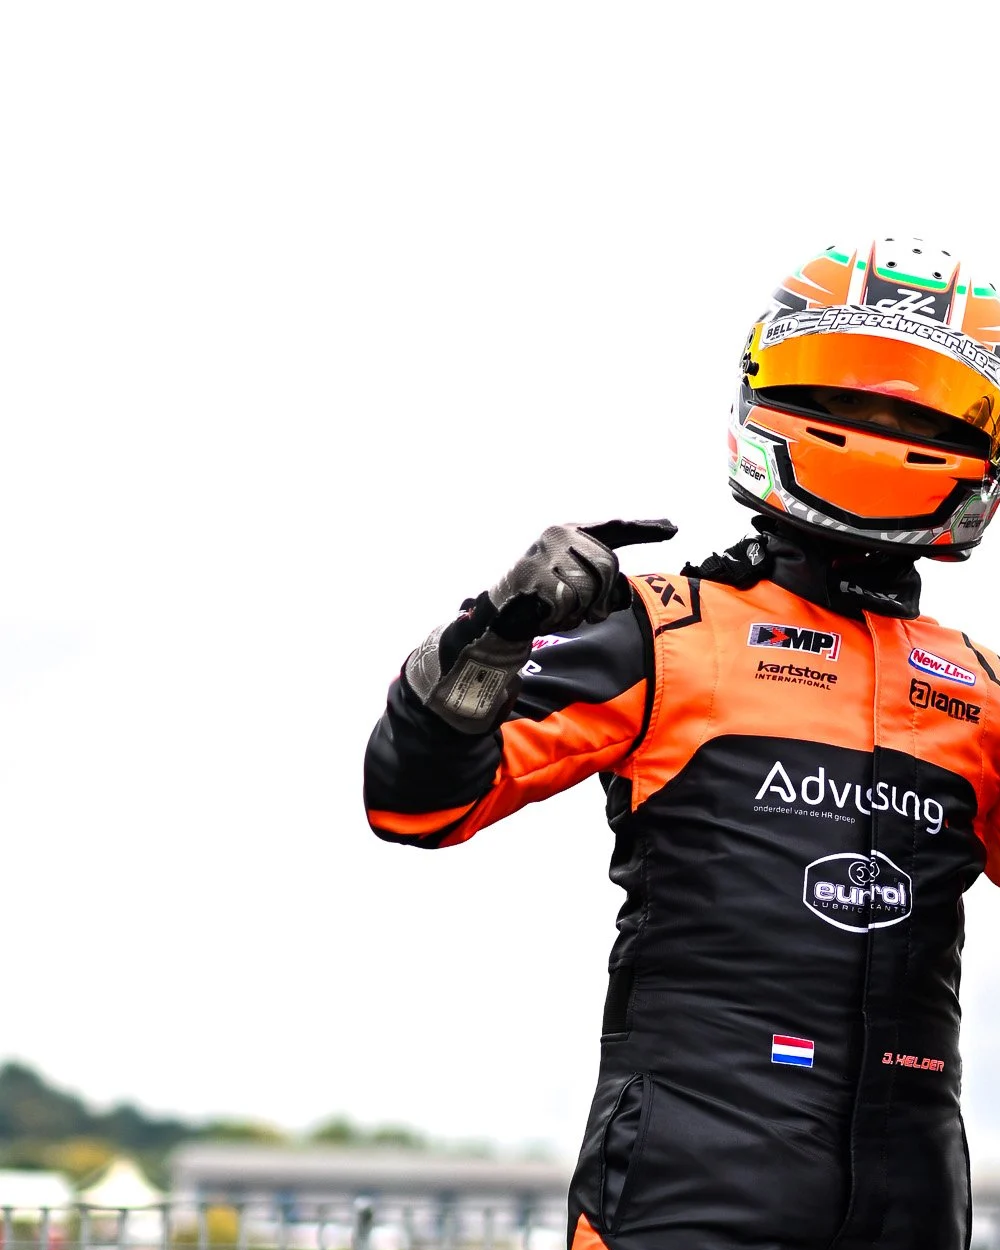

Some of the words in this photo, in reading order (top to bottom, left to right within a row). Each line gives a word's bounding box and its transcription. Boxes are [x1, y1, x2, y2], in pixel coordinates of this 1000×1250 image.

[766, 321, 793, 339] BELL
[817, 308, 989, 368] Speedwear.be
[757, 660, 838, 684] kartstore
[754, 673, 832, 691] INTERNATIONAL
[753, 805, 793, 814] onderdeel
[794, 808, 808, 816] van
[809, 810, 820, 818] de
[821, 811, 833, 819] HR
[834, 813, 856, 824] groep
[895, 1053, 945, 1073] HELDER
